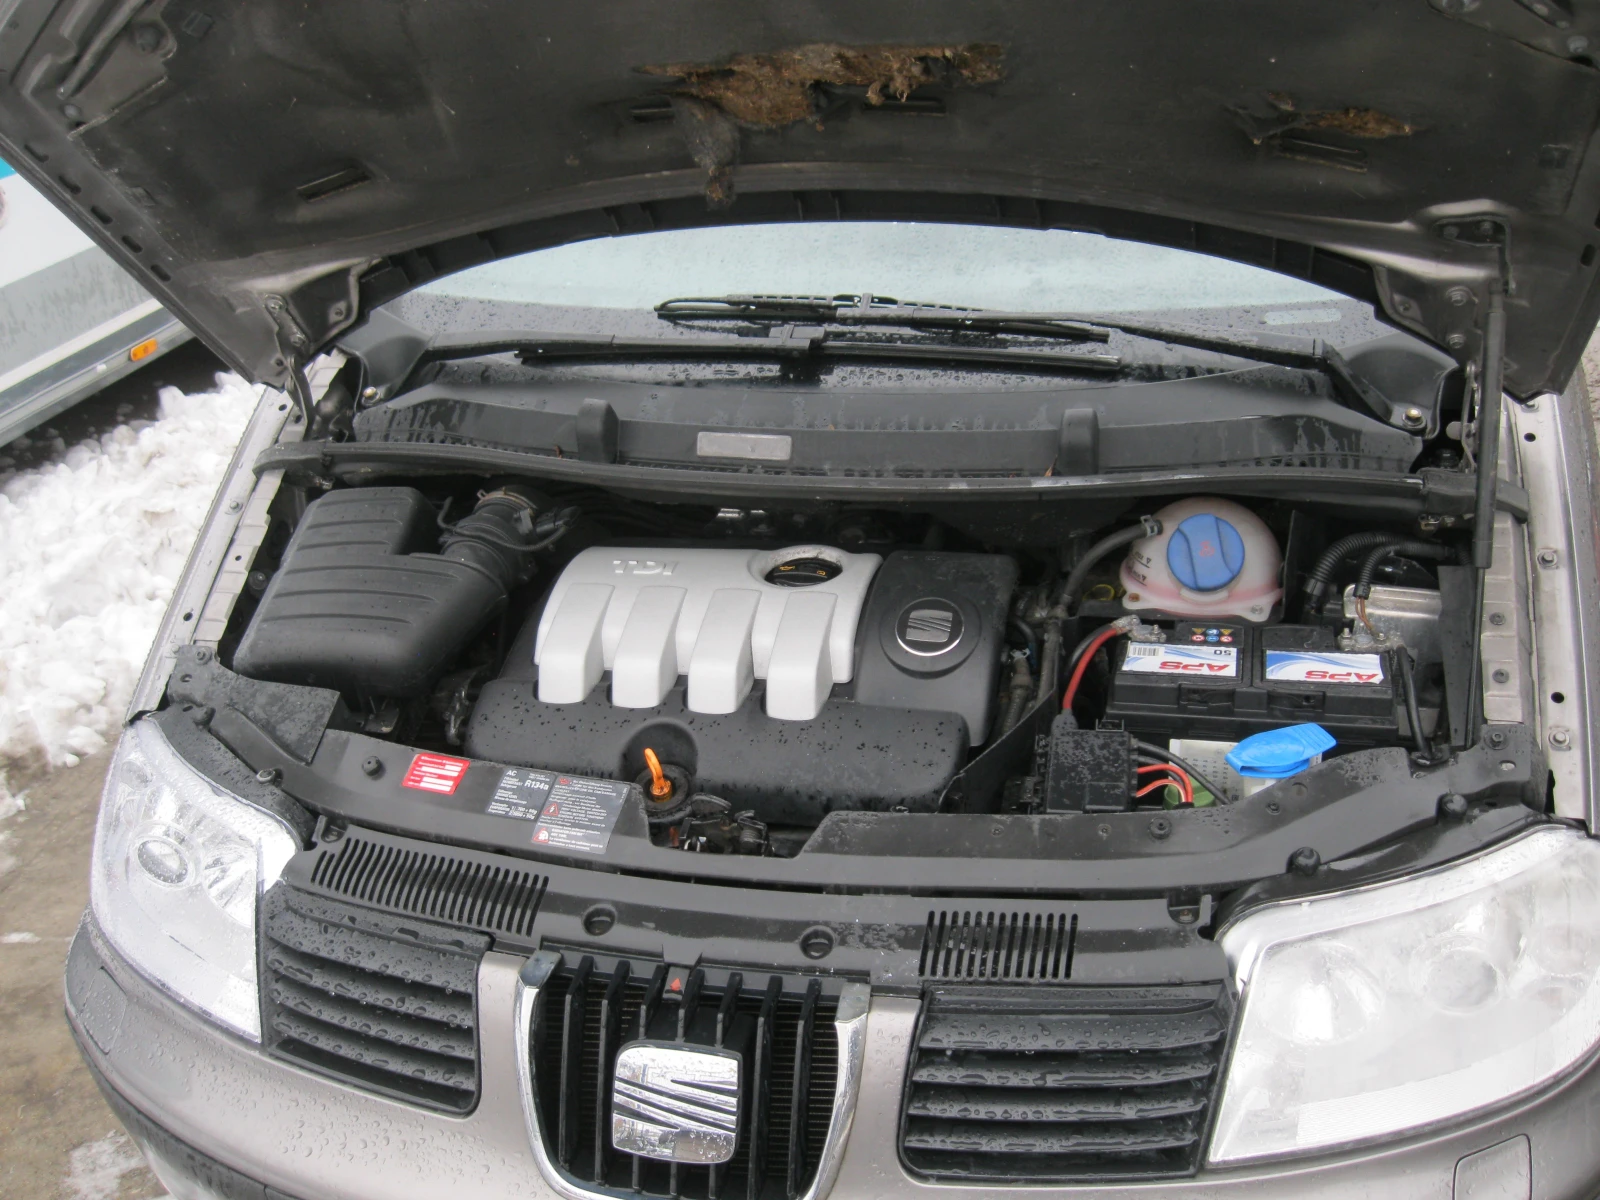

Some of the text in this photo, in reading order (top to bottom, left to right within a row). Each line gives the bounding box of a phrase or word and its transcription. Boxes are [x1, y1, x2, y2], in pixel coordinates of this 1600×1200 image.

[613, 560, 679, 575] TDI
[1159, 661, 1230, 673] APS
[1305, 670, 1379, 683] APS
[524, 779, 550, 790] R134a
